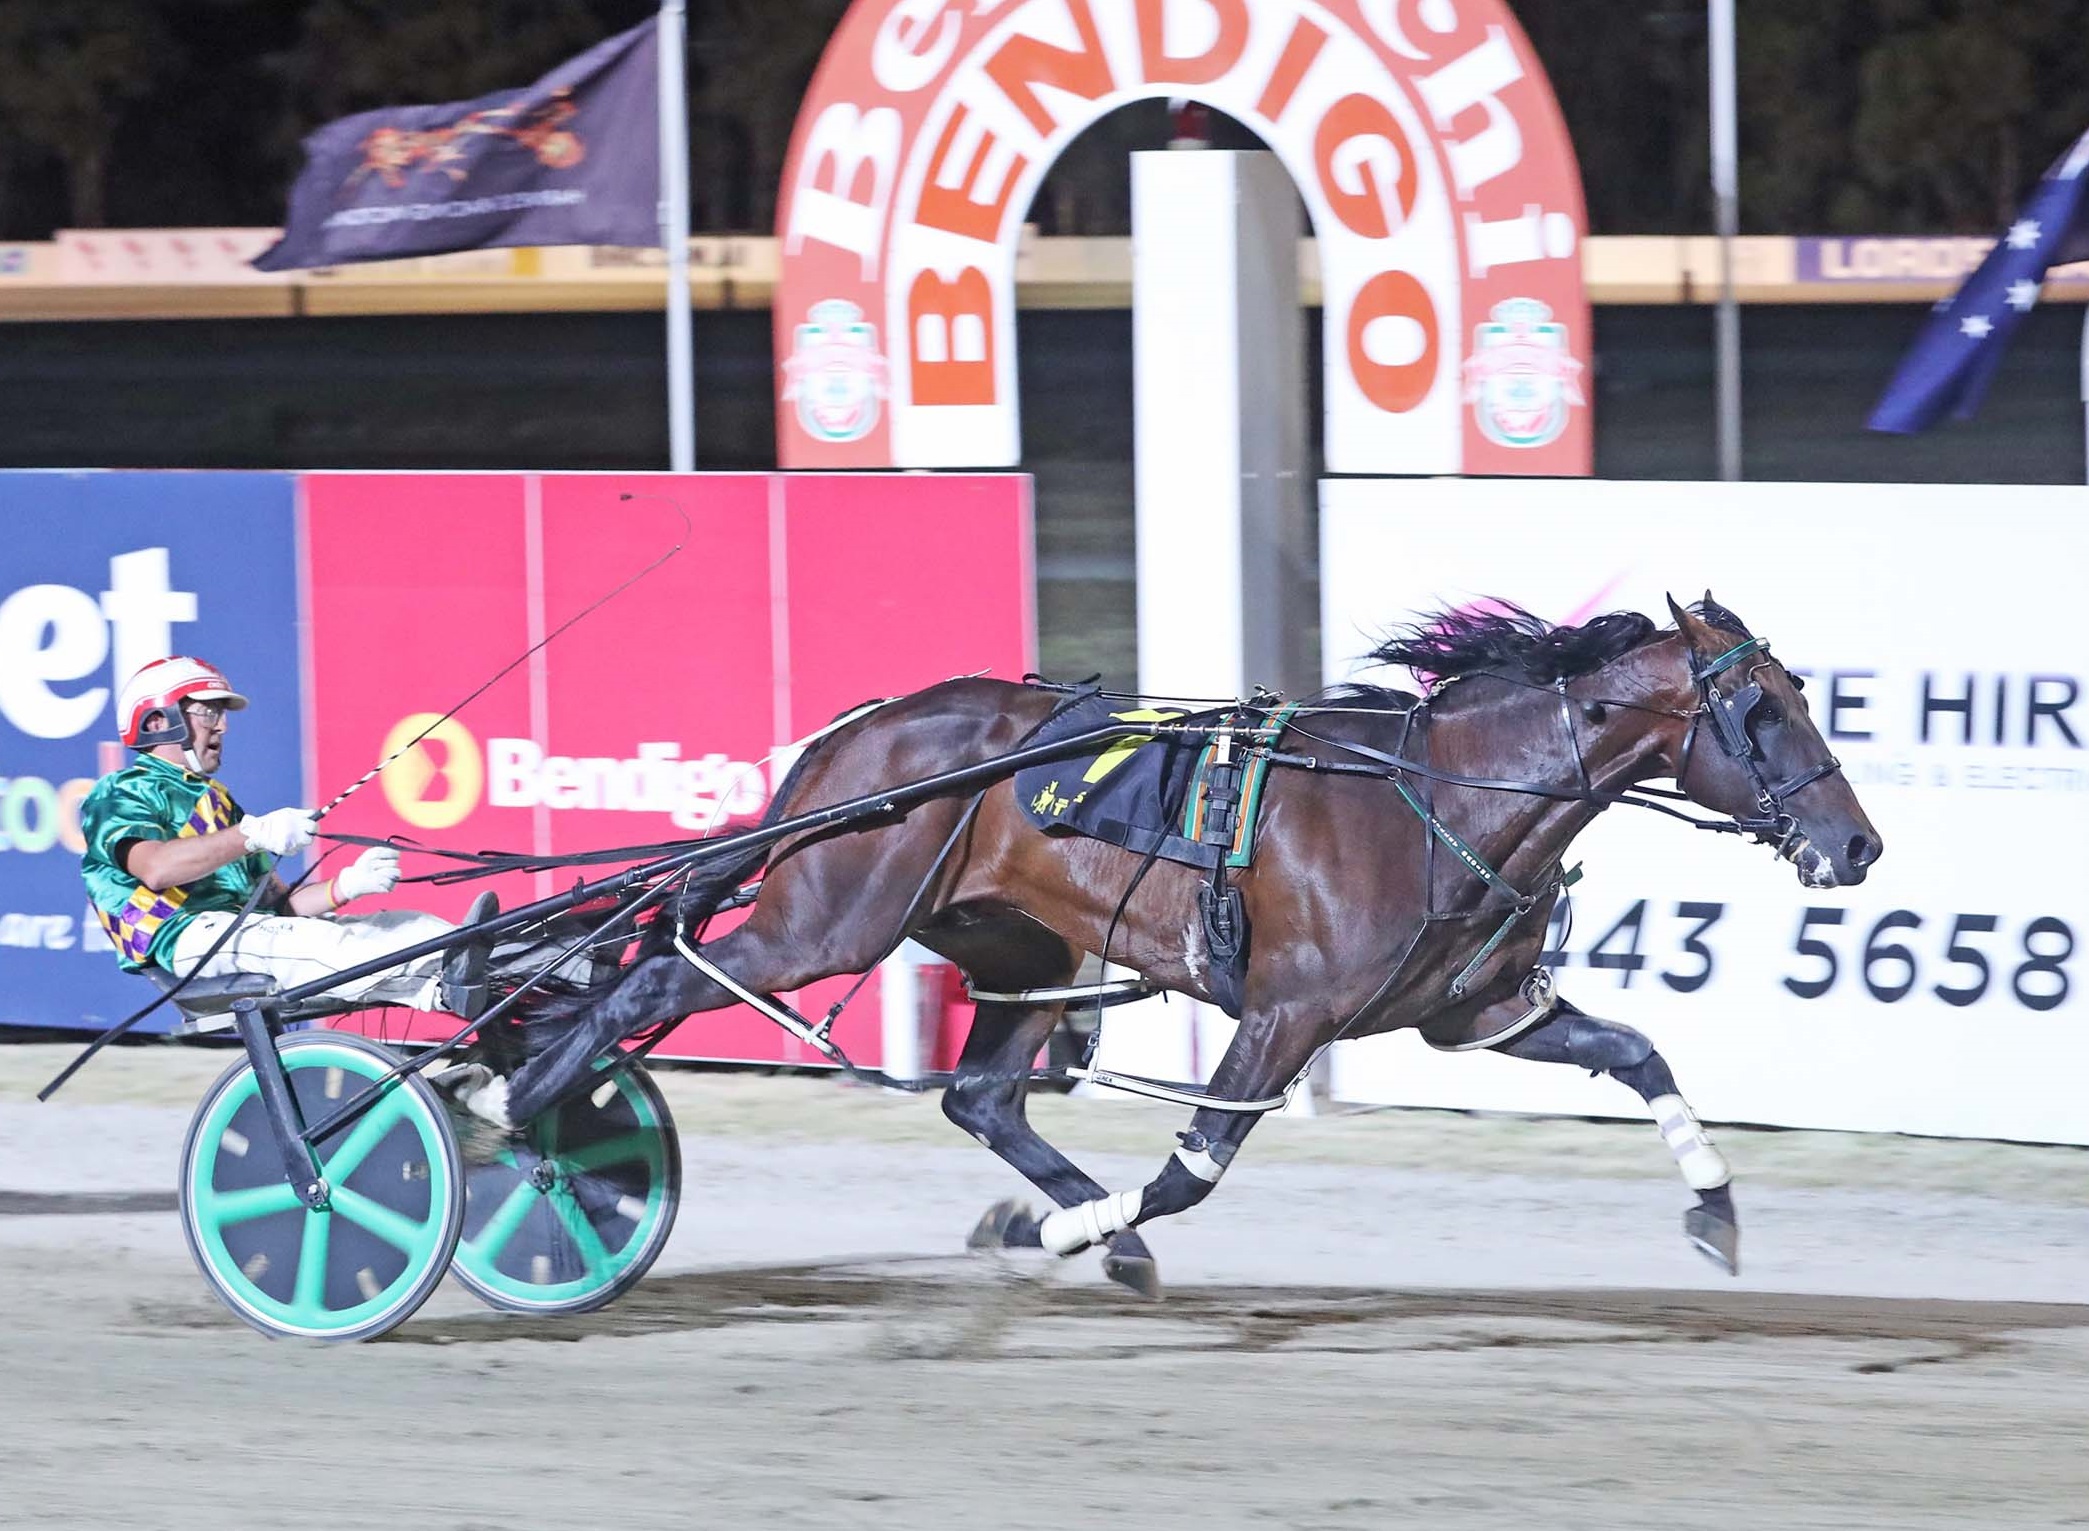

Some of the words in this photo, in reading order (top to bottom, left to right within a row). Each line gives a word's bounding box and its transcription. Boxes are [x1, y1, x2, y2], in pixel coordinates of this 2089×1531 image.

[908, 0, 1440, 413] BENDIGO
[487, 738, 767, 830] Bendigo
[1783, 906, 2075, 1012] 5658
